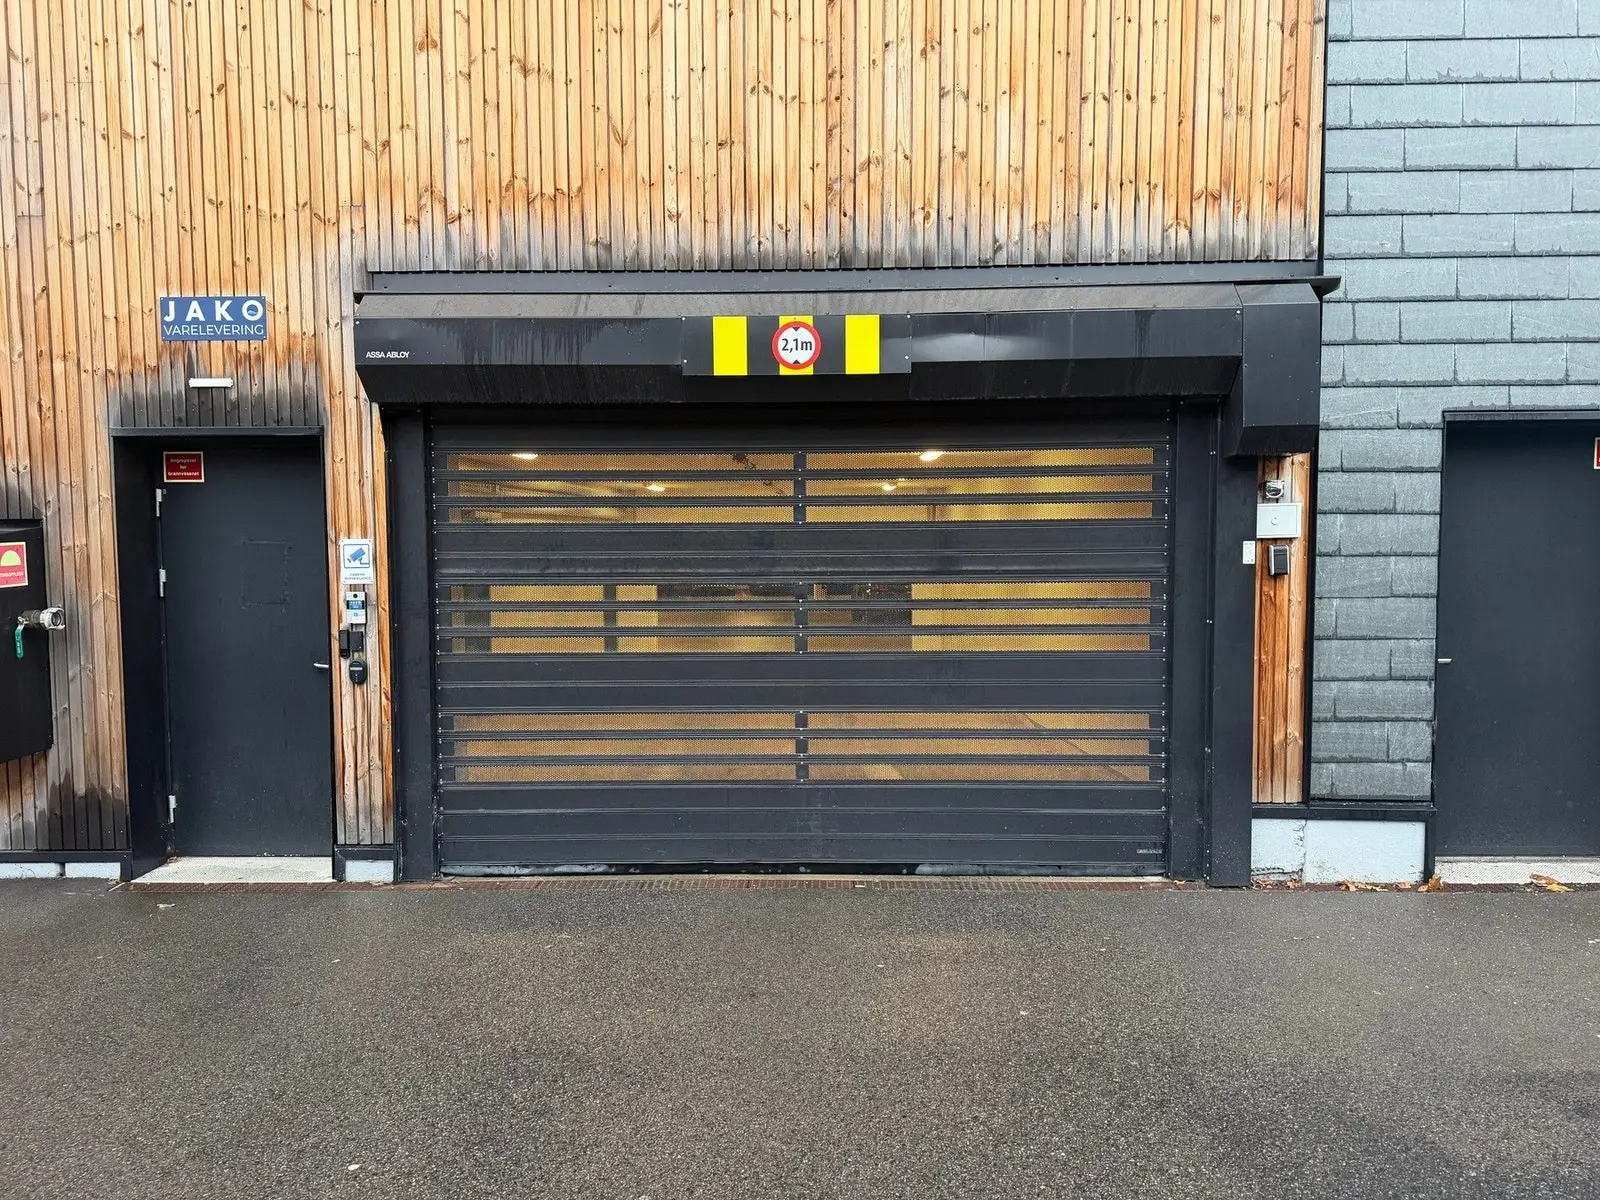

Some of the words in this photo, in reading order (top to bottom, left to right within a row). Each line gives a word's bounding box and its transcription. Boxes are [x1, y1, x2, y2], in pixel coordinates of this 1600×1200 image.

[163, 299, 263, 322] JAKO
[163, 324, 264, 336] VARELEVERING
[781, 338, 812, 353] 2,1m
